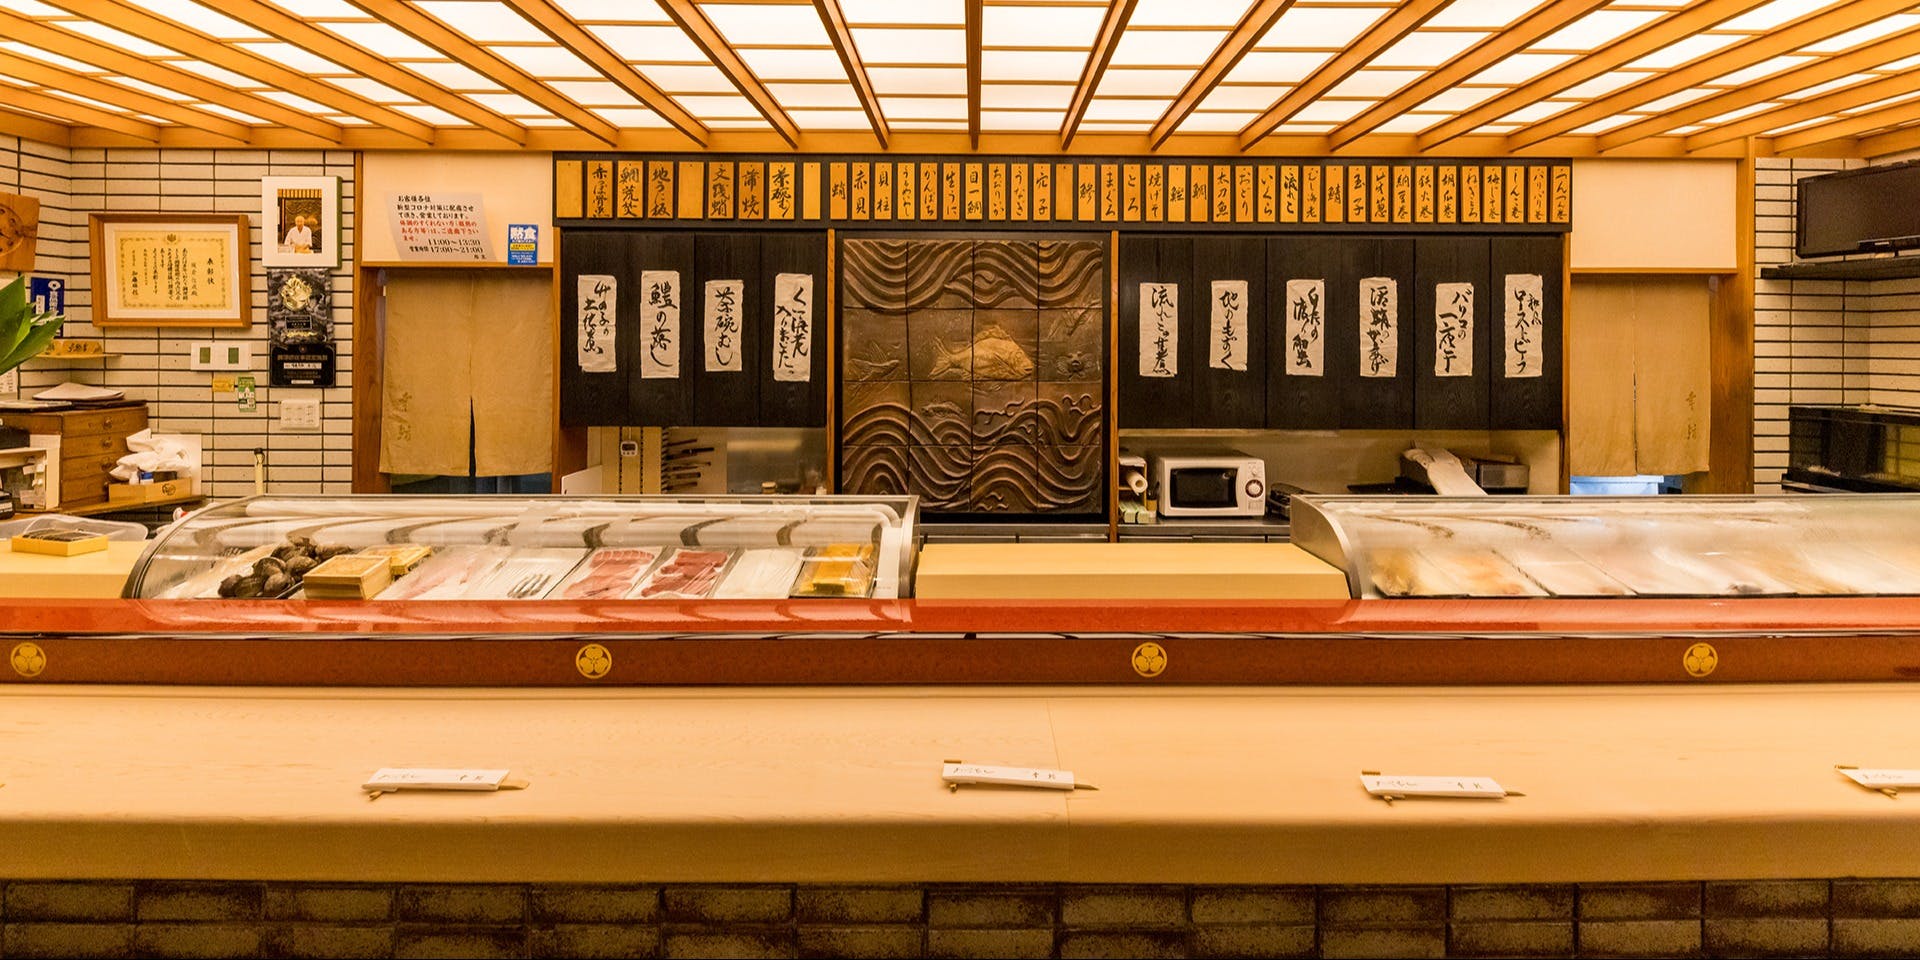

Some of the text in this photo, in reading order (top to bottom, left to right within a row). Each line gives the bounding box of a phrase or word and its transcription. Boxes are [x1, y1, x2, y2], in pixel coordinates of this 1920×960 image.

[742, 169, 760, 218] 蒲焼
[854, 170, 867, 214] 赤貝
[877, 171, 889, 212] 貝柱
[1015, 170, 1025, 216] うなぎ
[1036, 172, 1048, 215] 穴子
[1105, 172, 1116, 216] まぐろ
[1127, 174, 1138, 213] とろ
[1216, 172, 1229, 217] 太刀魚
[1261, 174, 1272, 216] いくら
[1353, 173, 1365, 215] 玉子
[1419, 175, 1432, 218] 鉄火巻
[510, 226, 537, 241] 黙食
[715, 287, 739, 366] 茶碗むし
